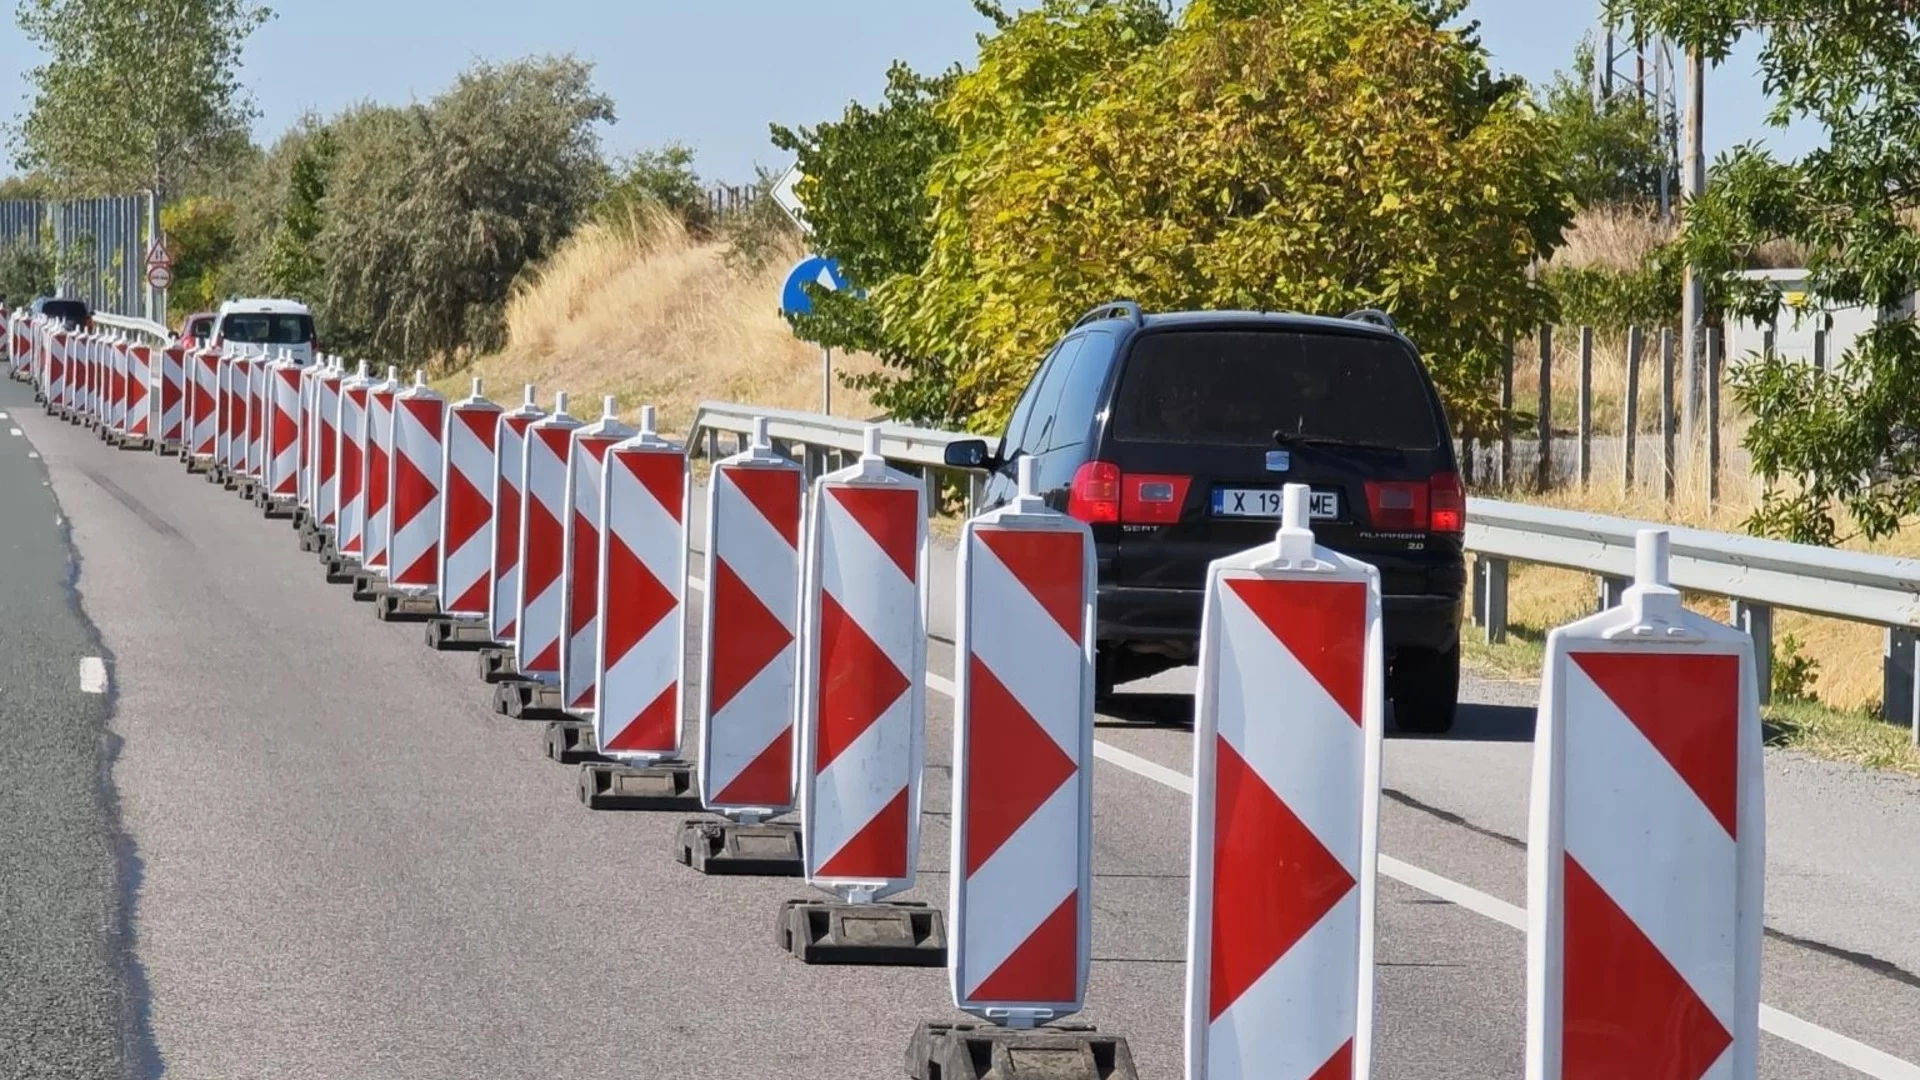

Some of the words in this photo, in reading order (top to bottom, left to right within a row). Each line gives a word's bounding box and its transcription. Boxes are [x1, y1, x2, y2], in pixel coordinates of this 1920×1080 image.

[1233, 492, 1245, 512] X
[1259, 493, 1283, 513] 19
[1309, 495, 1333, 515] ME
[1359, 532, 1426, 540] ALHAMBRA
